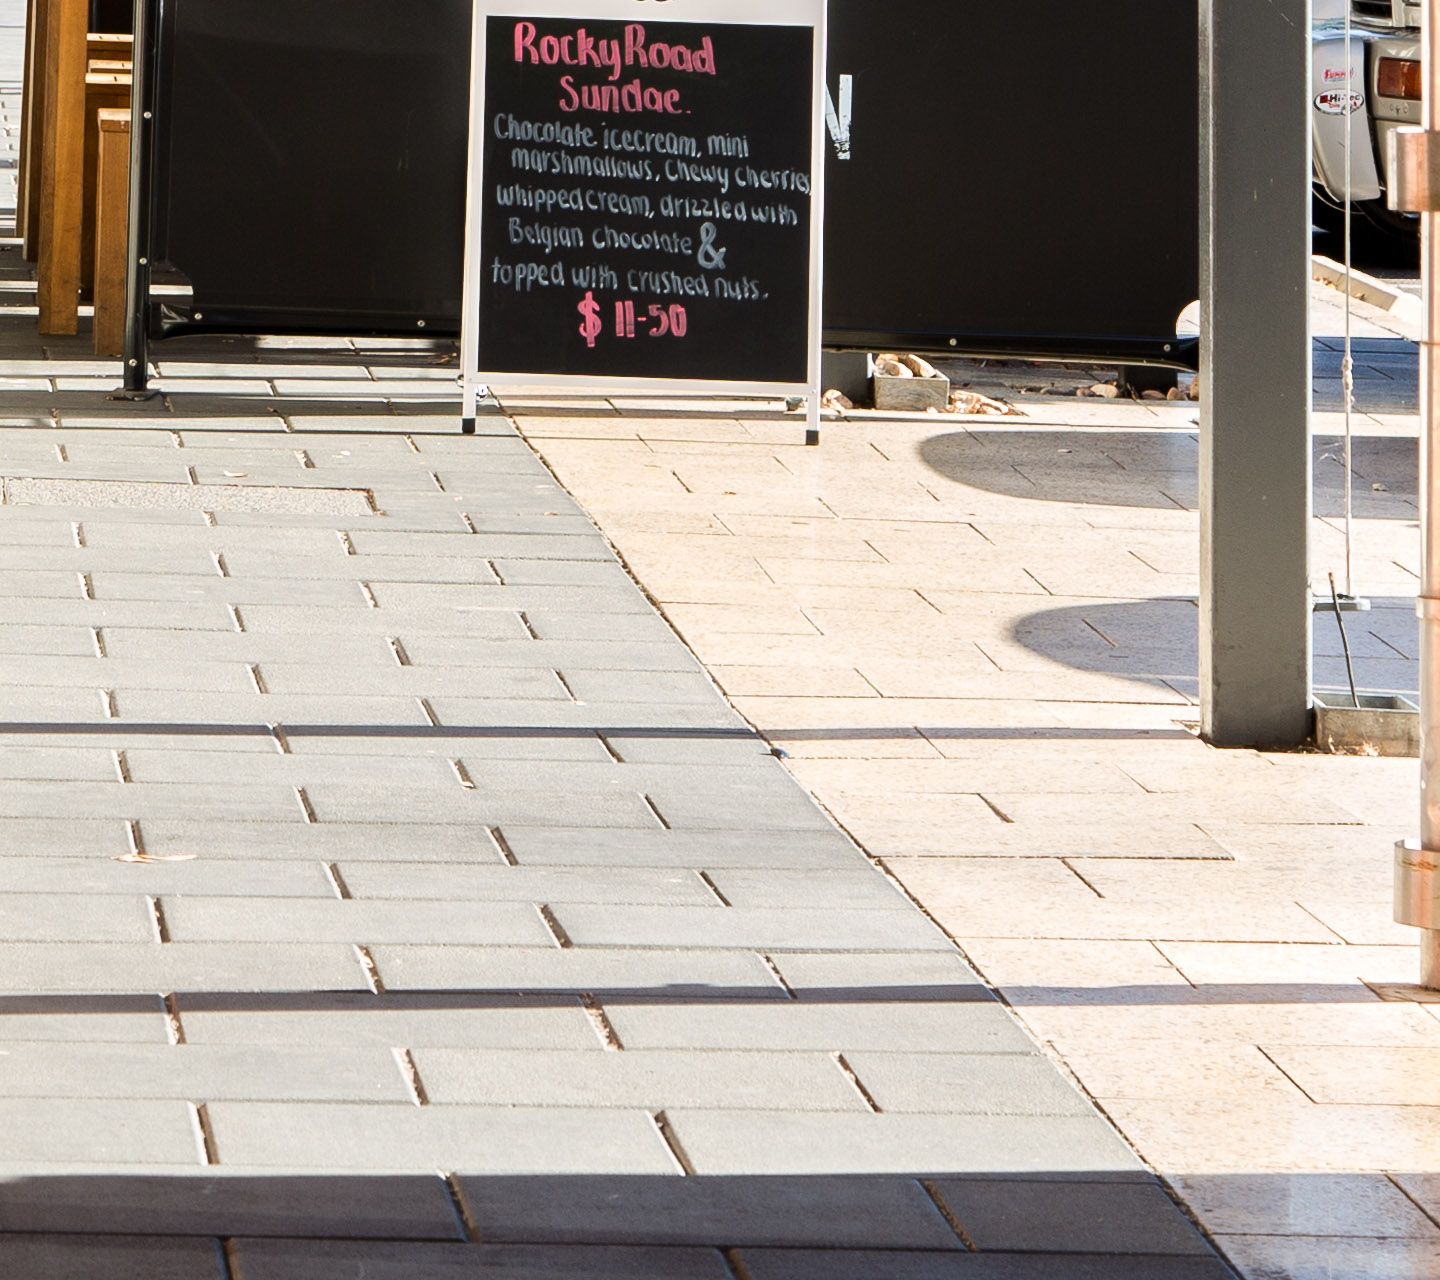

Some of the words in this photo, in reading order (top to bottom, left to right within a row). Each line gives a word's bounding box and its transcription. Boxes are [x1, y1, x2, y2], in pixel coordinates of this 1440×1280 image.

[514, 21, 621, 81] Rocky
[624, 23, 717, 76] Road
[559, 75, 692, 114] Sundae.
[494, 113, 598, 147] Chocolate
[707, 133, 750, 158] mini
[751, 202, 798, 225] with
[508, 216, 584, 255] Belgian
[592, 225, 692, 255] chocolate
[697, 222, 727, 270] &
[491, 256, 565, 291] topped
[572, 264, 618, 290] with
[627, 269, 710, 297] crushed
